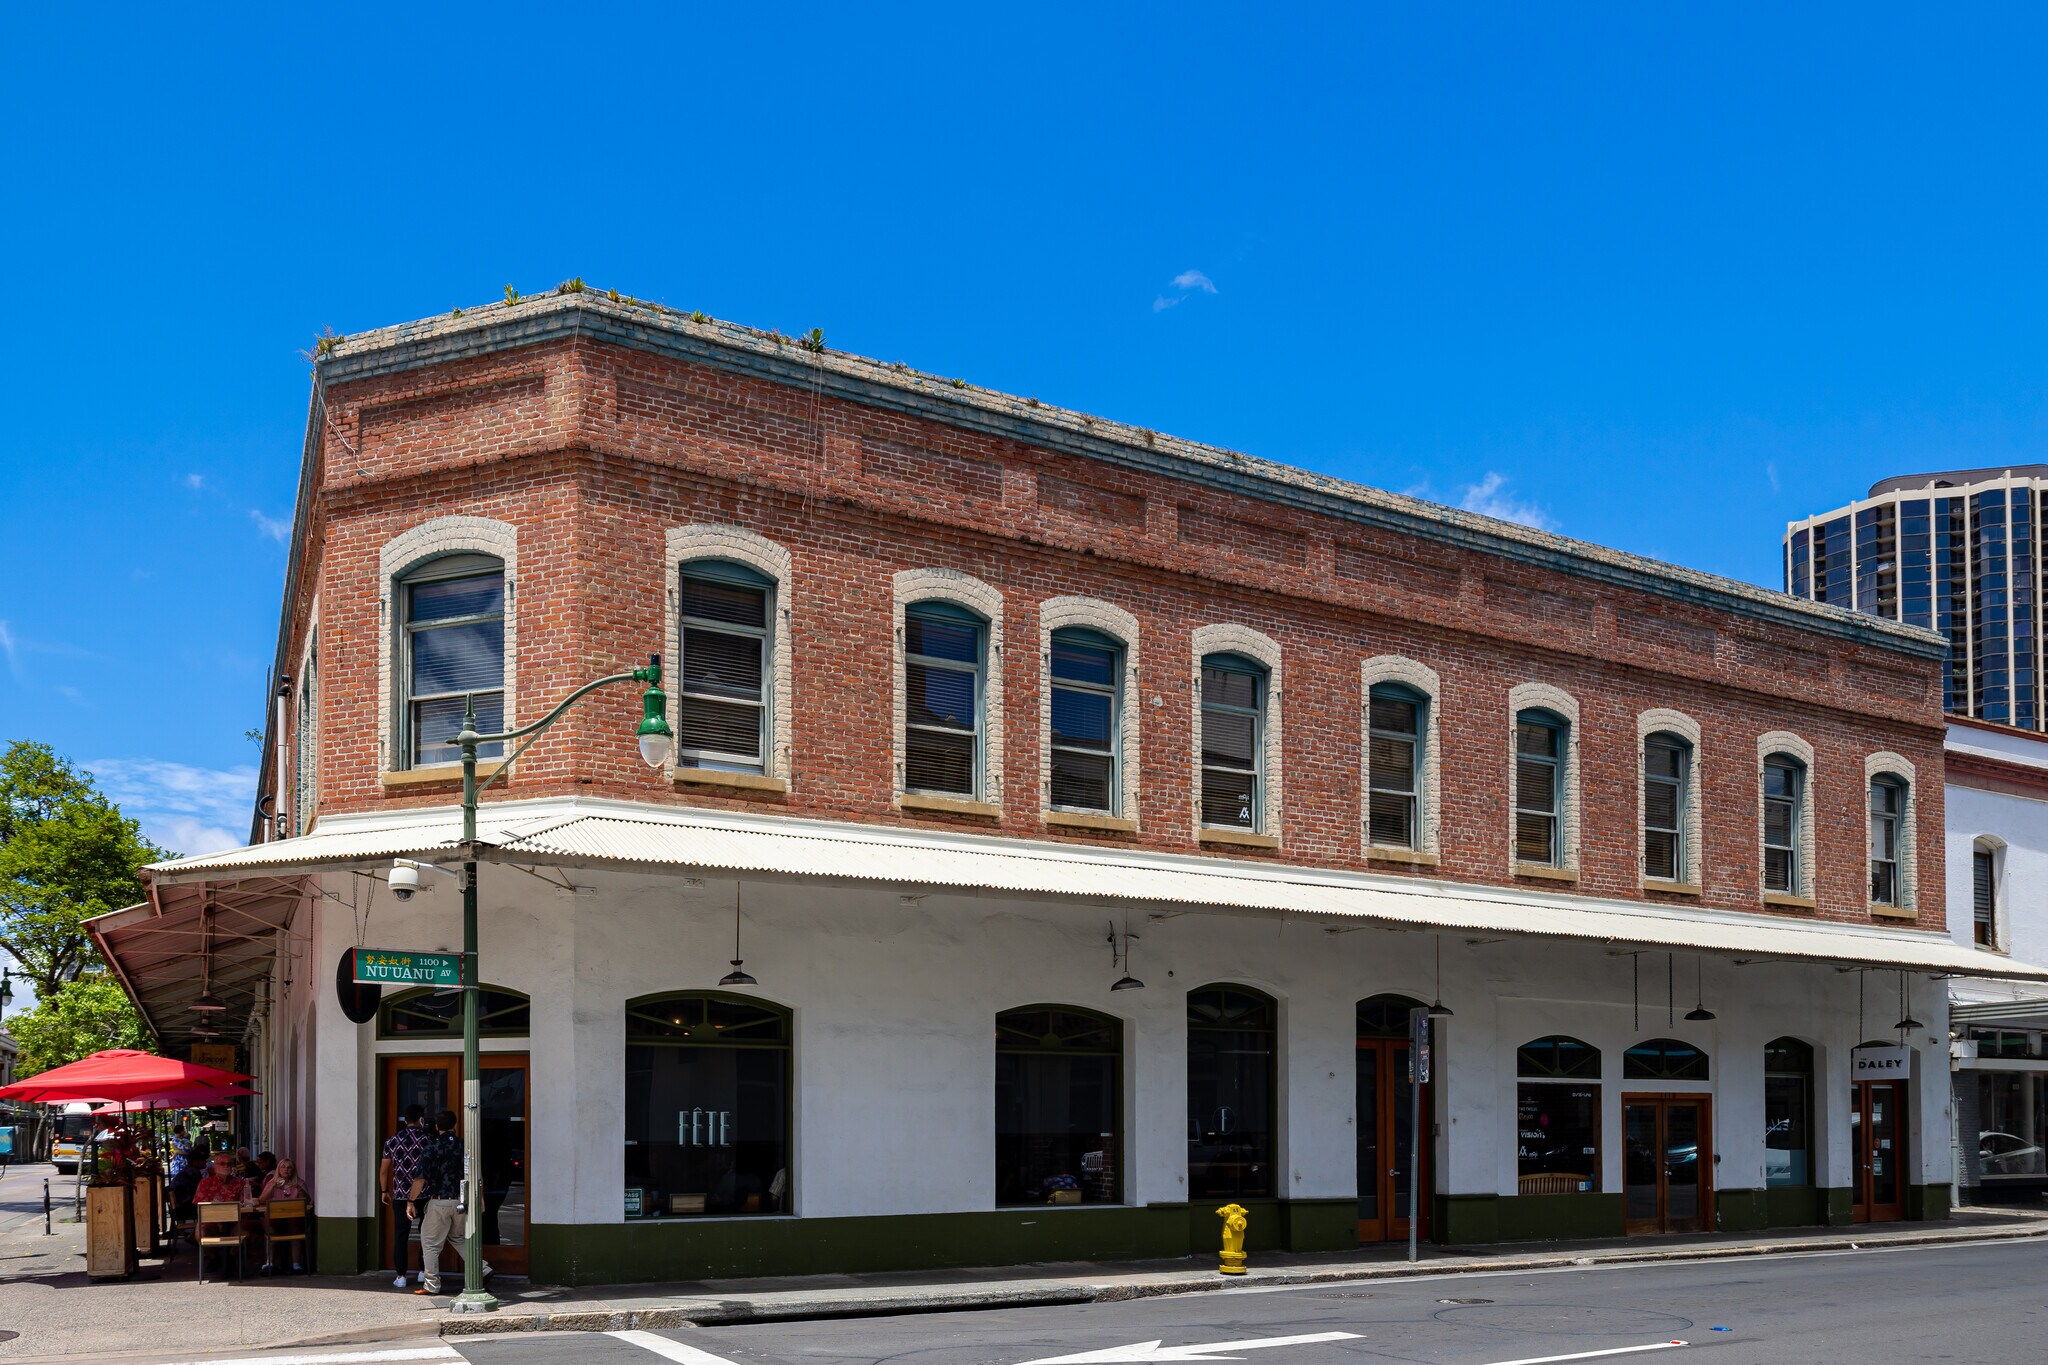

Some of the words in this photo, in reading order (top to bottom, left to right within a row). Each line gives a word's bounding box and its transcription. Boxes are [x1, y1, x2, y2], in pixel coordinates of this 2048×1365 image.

[419, 958, 439, 966] 1100
[1858, 1059, 1902, 1069] DALEY
[678, 1107, 732, 1147] FÊTE
